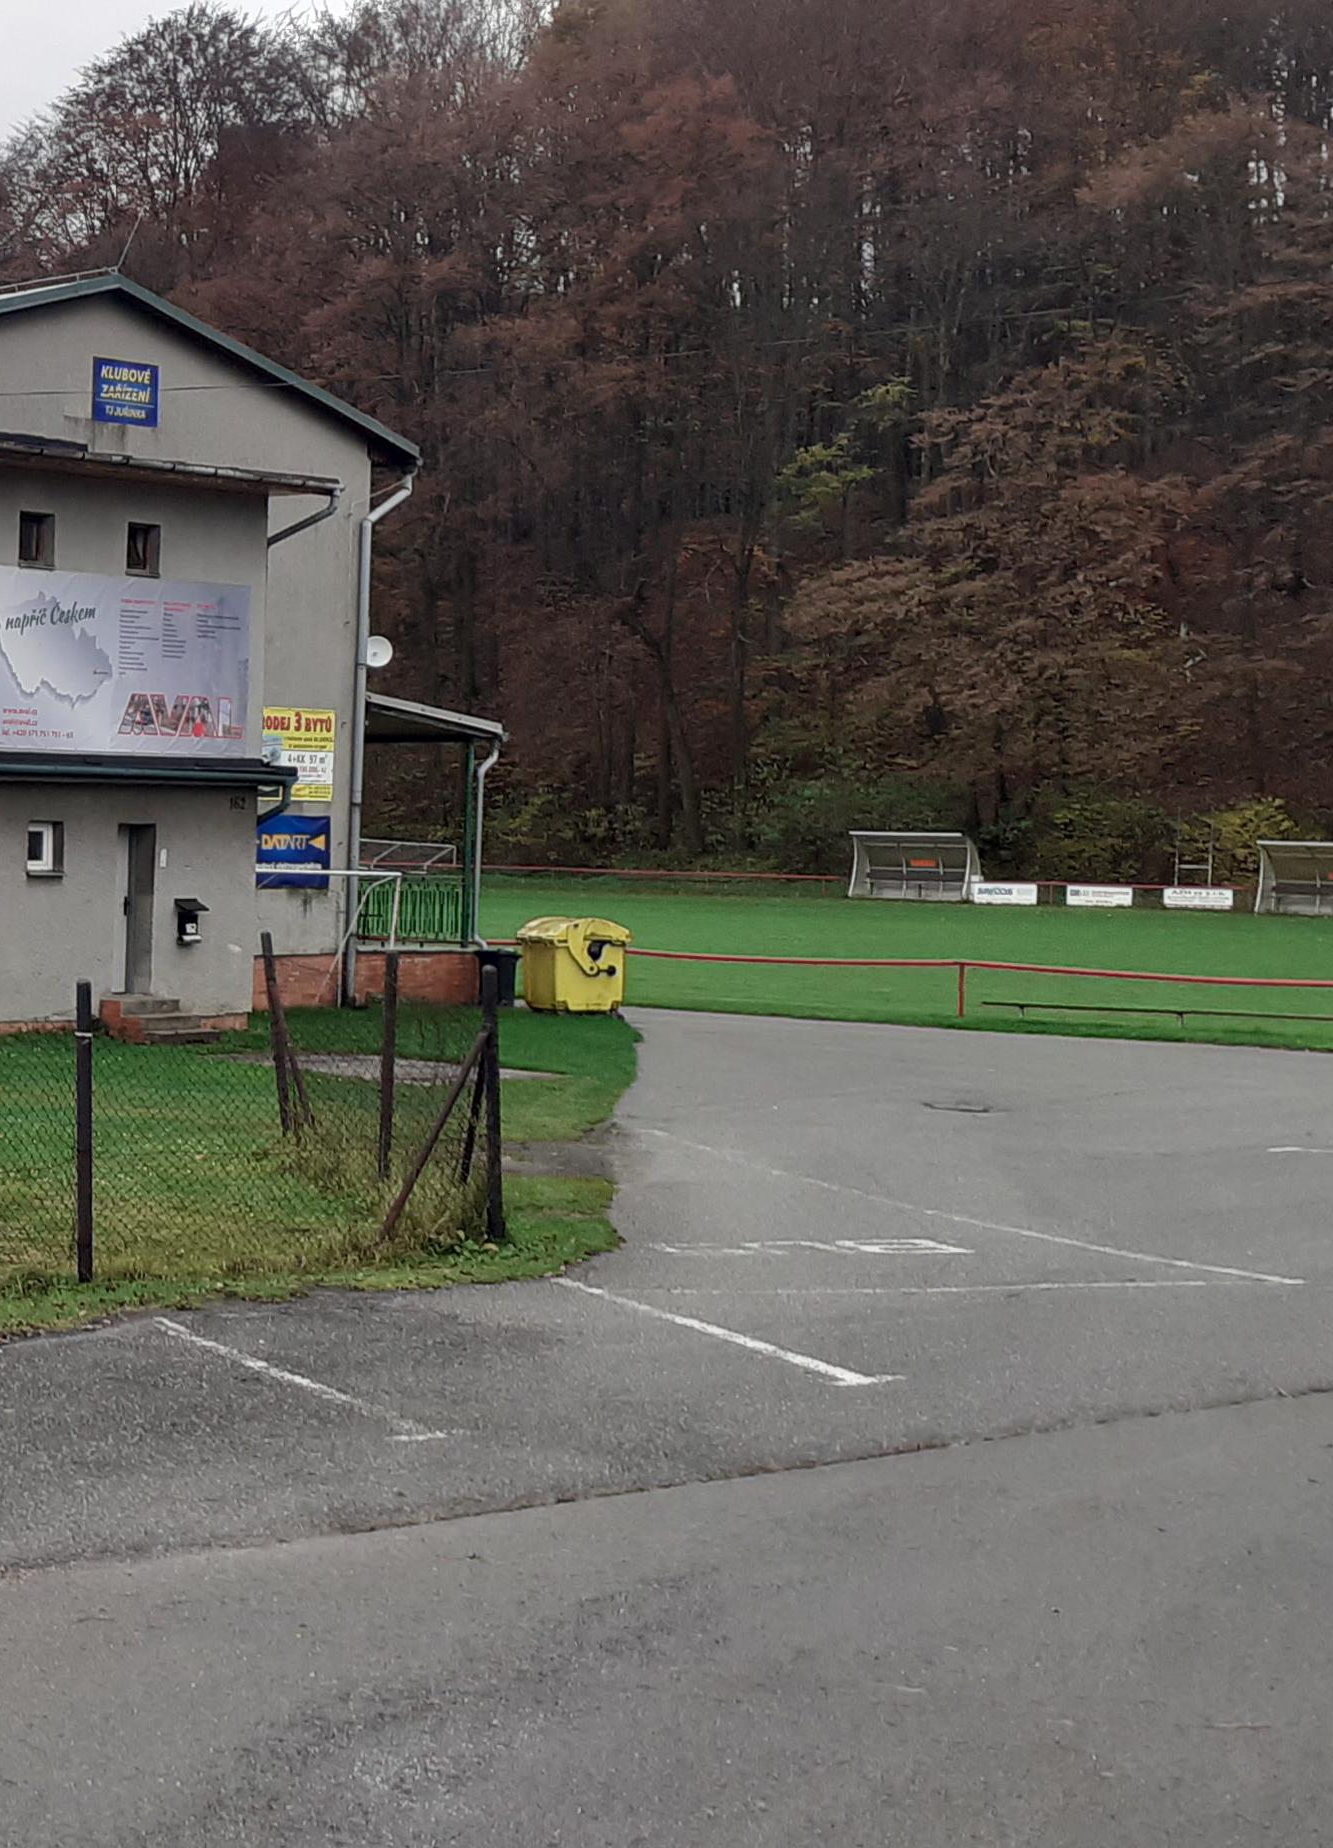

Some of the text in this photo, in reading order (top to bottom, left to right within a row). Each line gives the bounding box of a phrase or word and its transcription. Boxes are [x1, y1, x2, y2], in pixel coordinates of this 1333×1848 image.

[101, 366, 151, 384] KLUBOVÉ
[101, 384, 150, 403] ZAŘÍZENÍ
[5, 600, 96, 636] napříč Českem
[117, 693, 245, 739] AVAL
[293, 711, 302, 732] 3
[304, 714, 332, 733] BYTŮ
[229, 796, 246, 810] 162
[261, 834, 310, 851] DATART
